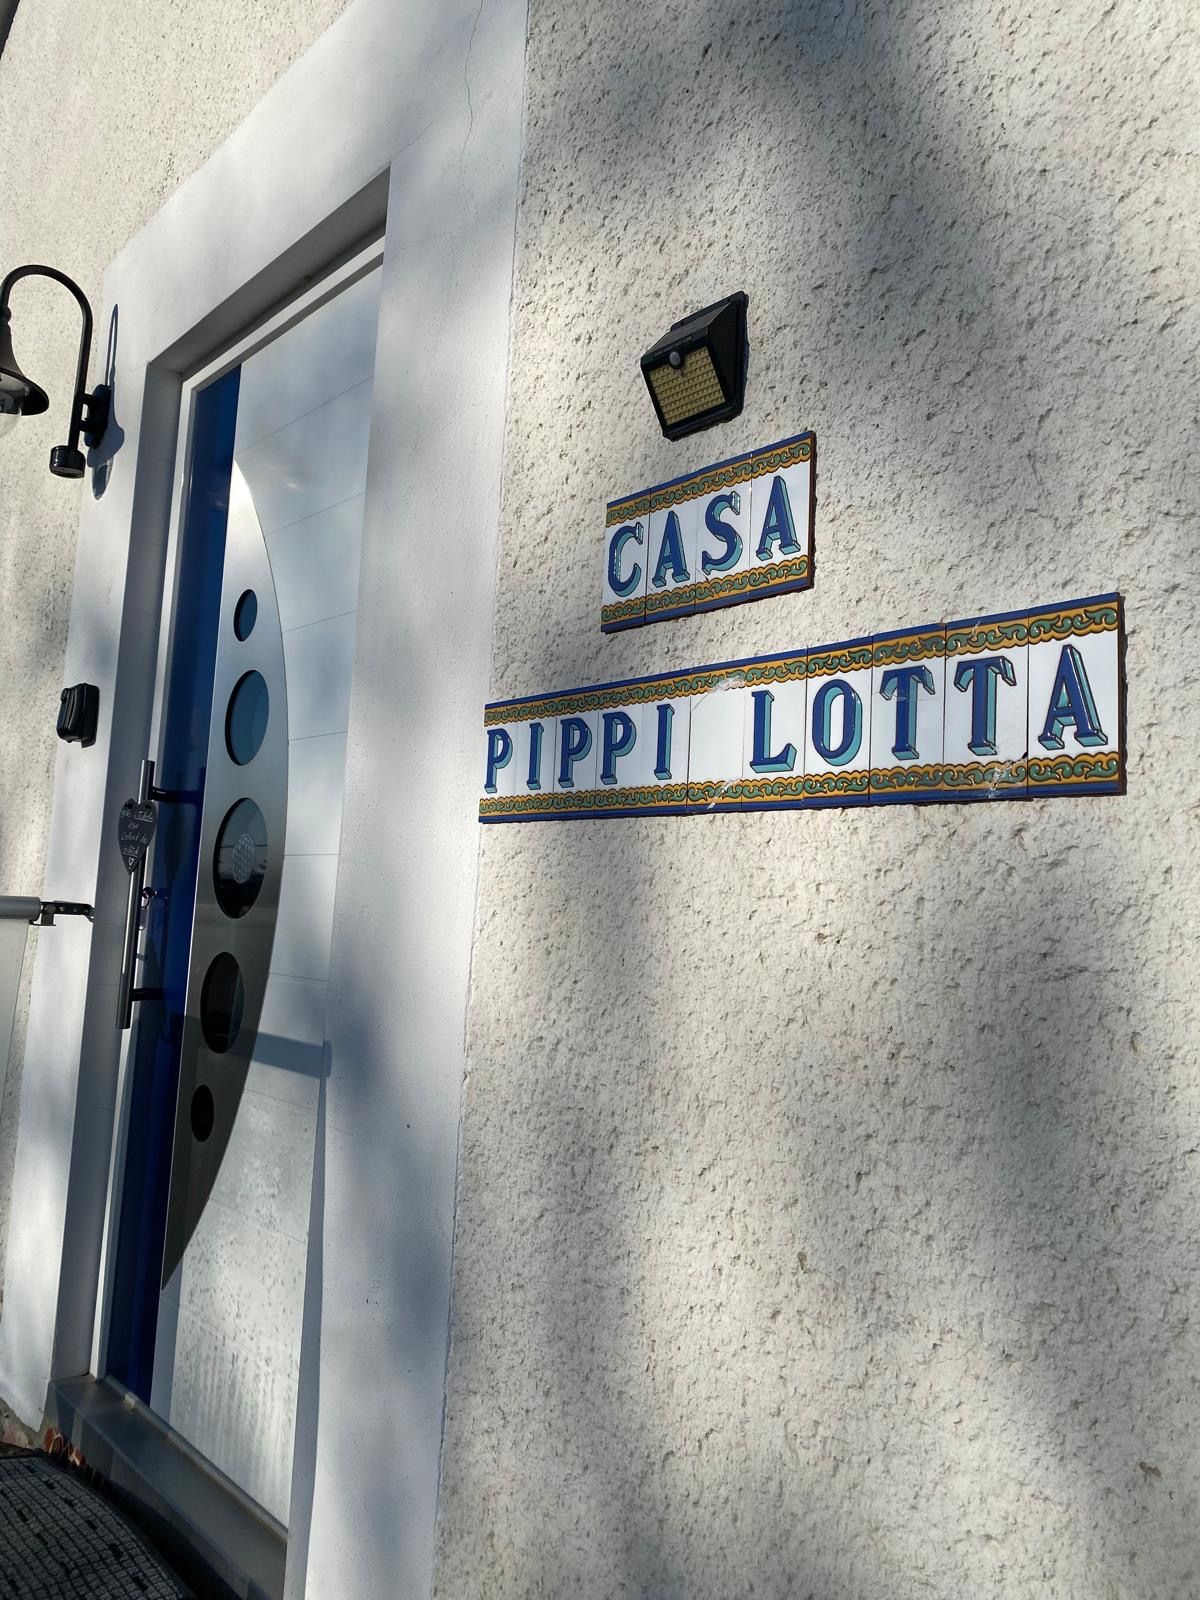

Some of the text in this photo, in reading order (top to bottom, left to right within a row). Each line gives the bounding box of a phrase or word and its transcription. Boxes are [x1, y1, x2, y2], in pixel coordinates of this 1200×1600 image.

[607, 475, 801, 598] CASA
[485, 644, 1109, 794] PIPPI LOTTA
